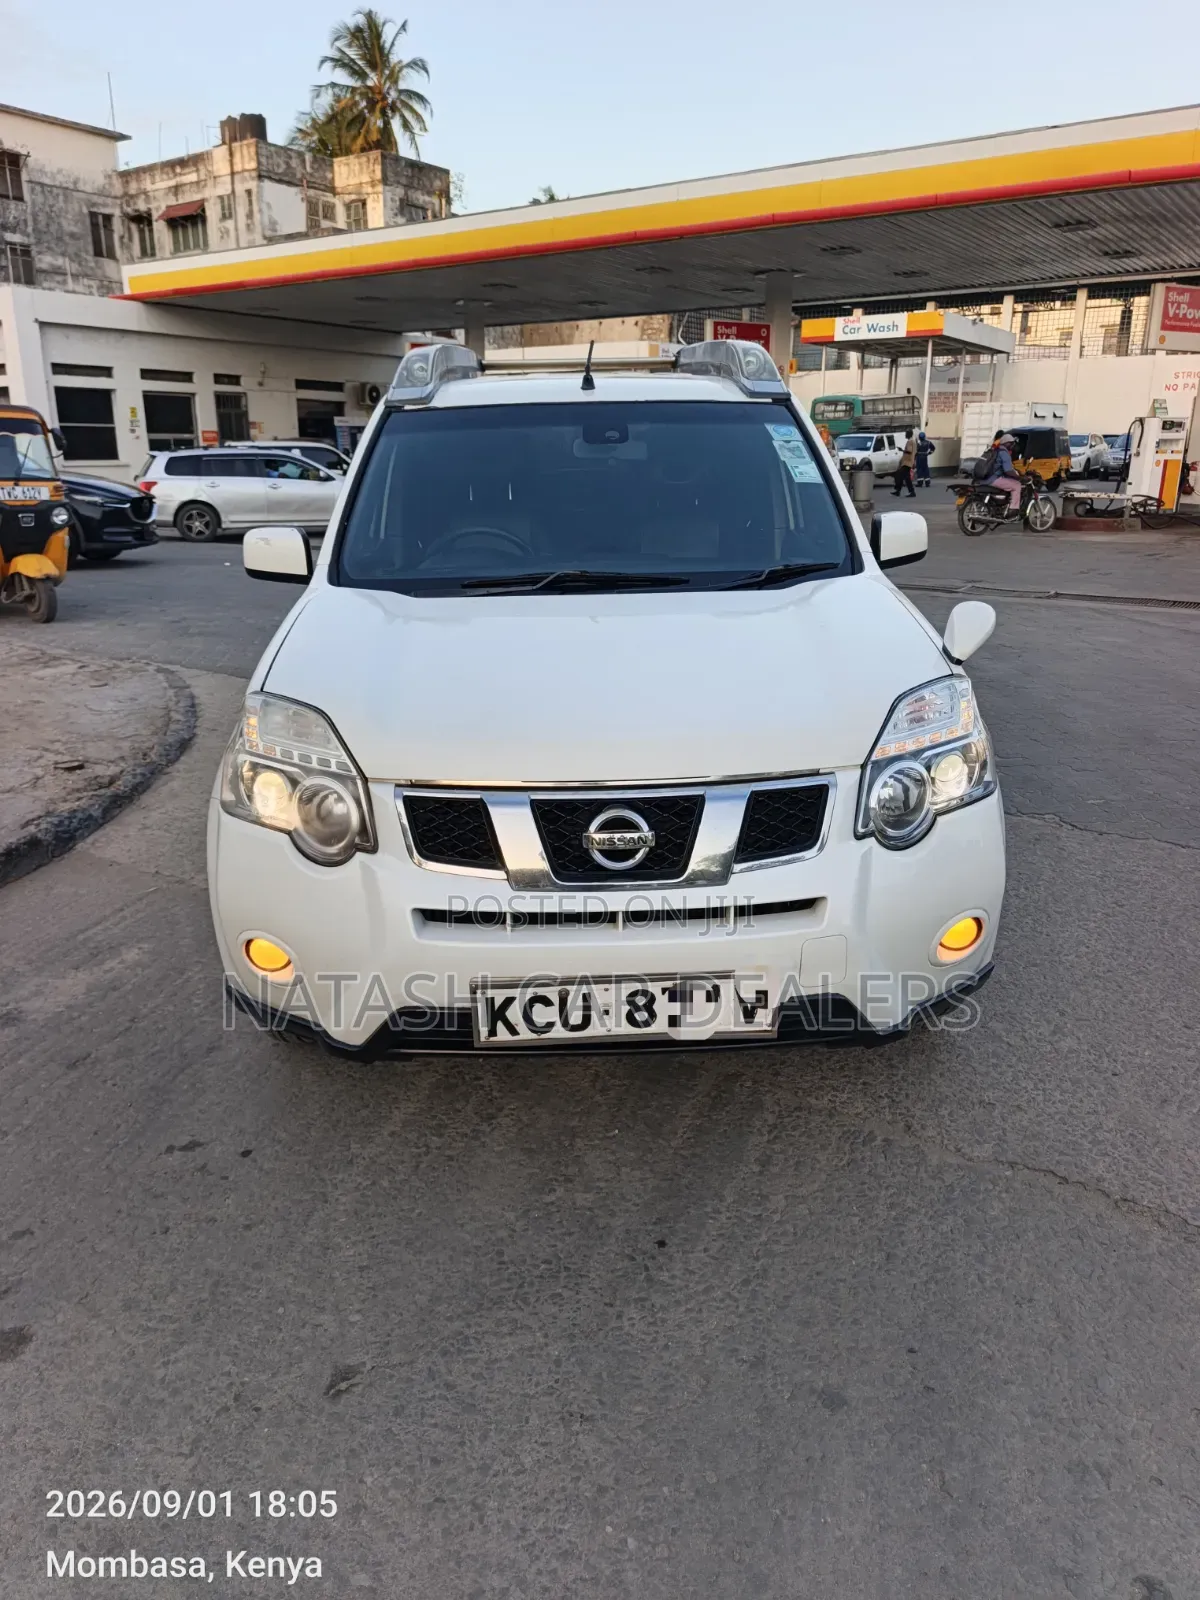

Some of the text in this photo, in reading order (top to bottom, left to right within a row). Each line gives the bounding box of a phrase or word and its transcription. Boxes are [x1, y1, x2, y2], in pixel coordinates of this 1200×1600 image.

[1168, 292, 1190, 303] Shell
[843, 317, 860, 325] Shell
[717, 325, 737, 335] Shell
[842, 320, 899, 335] Car Wash
[1164, 383, 1178, 391] NO
[591, 835, 648, 846] NISSAN
[485, 992, 592, 1037] KCU
